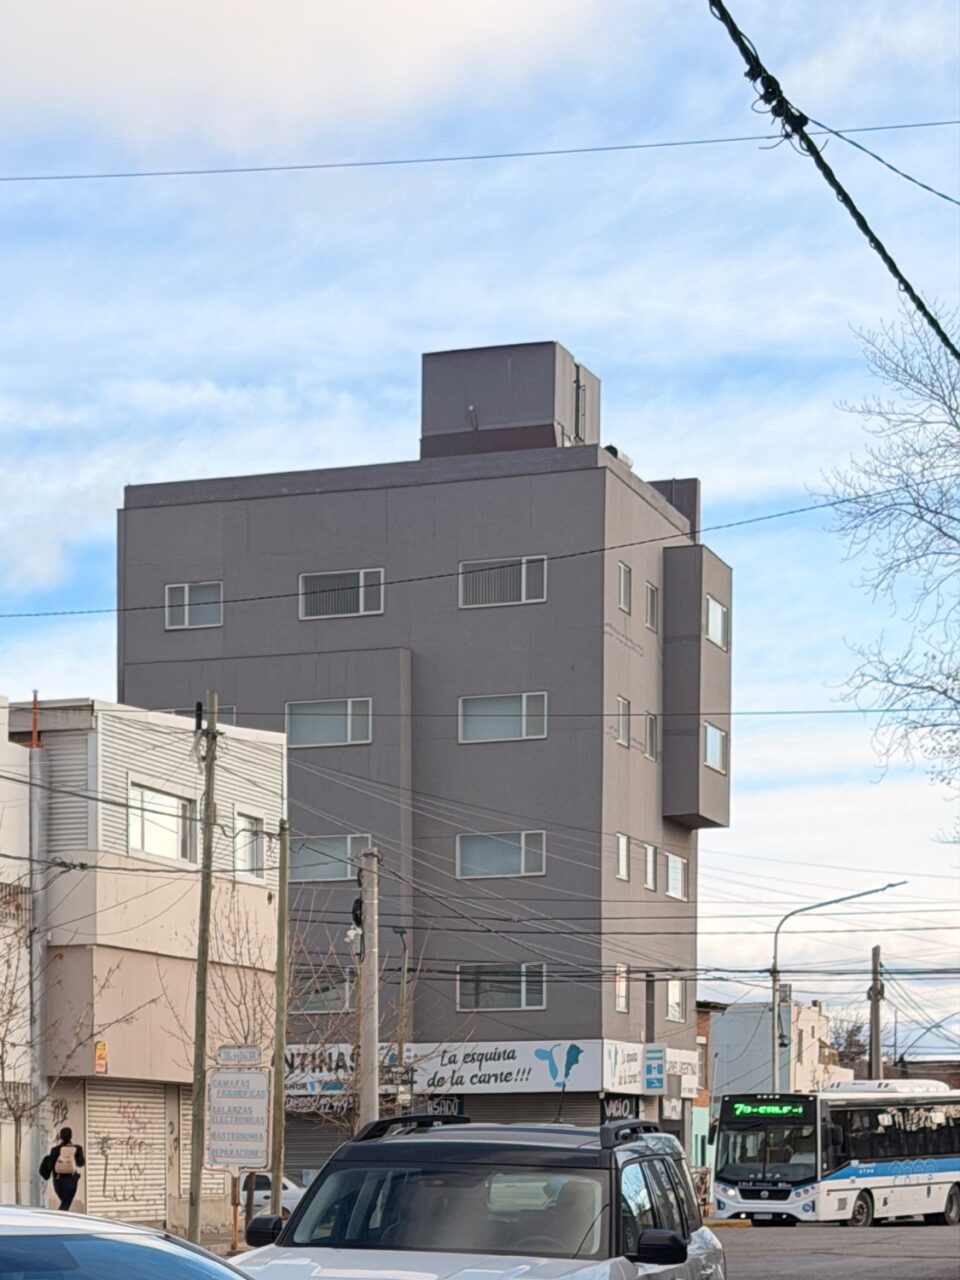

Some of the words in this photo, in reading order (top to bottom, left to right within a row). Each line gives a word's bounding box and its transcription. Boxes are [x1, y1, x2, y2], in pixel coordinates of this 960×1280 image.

[440, 1049, 458, 1067] La
[462, 1046, 518, 1071] esquina
[427, 1070, 446, 1088] de
[450, 1069, 466, 1087] la
[469, 1066, 532, 1085] carne!!!
